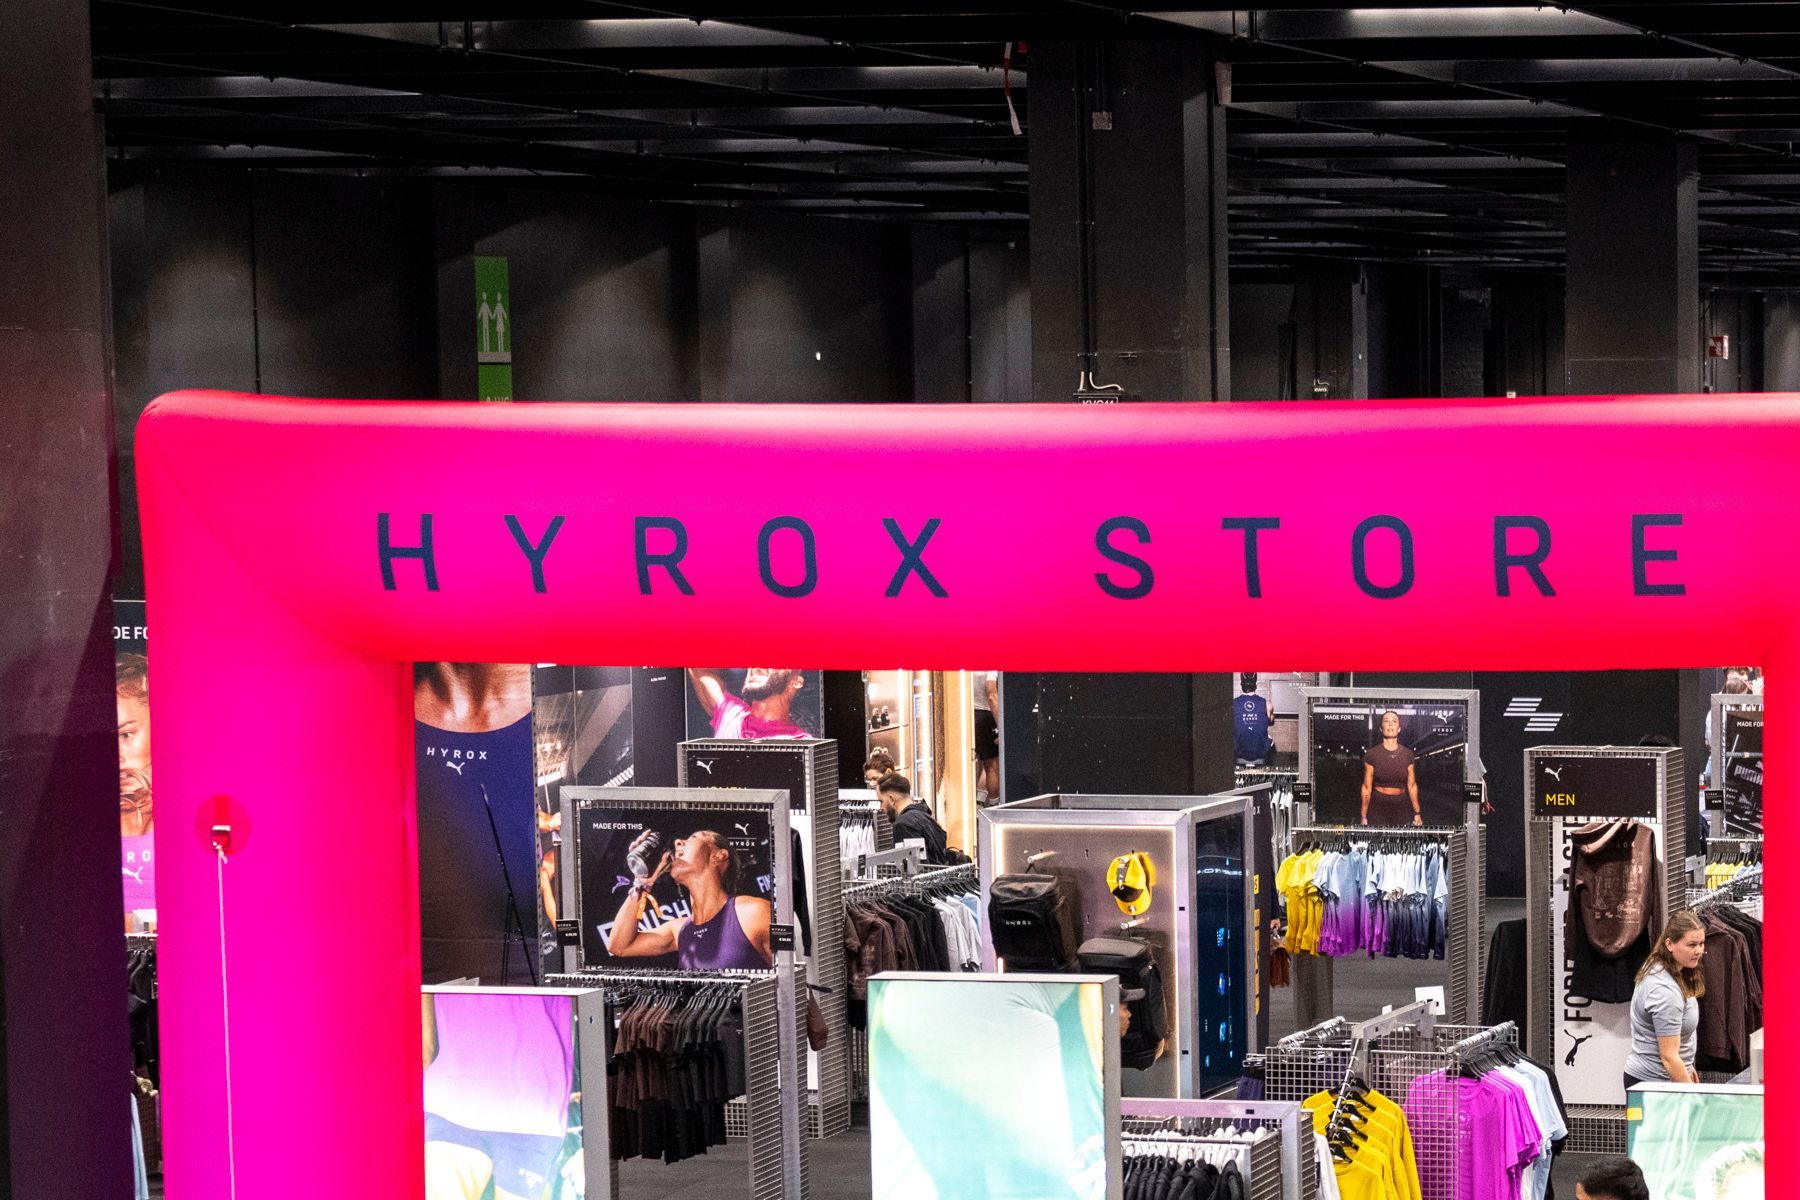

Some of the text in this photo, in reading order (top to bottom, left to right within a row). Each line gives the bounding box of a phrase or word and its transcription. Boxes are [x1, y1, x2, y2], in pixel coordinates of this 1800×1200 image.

[377, 512, 1687, 601] HYROX STORE
[426, 746, 488, 760] HYROX
[1545, 793, 1576, 806] MEN
[592, 822, 643, 830] MADE FOR THIS
